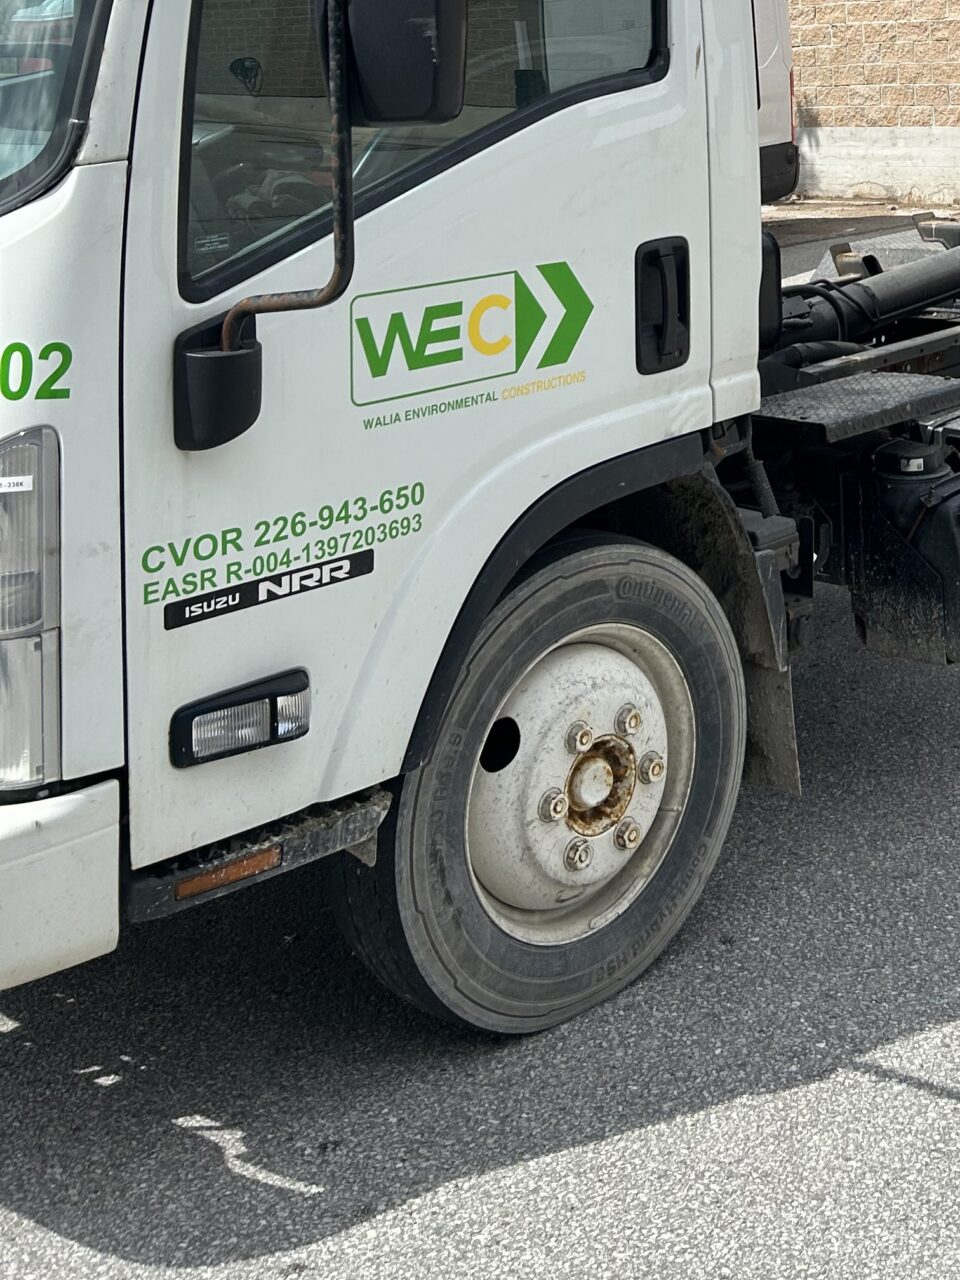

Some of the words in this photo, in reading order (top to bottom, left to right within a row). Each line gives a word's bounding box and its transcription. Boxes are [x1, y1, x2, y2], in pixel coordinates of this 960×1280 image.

[0, 341, 73, 401] 02
[355, 293, 513, 379] WEC
[363, 412, 402, 431] WALIA
[404, 391, 498, 422] ENVIRONMENTAL
[501, 370, 587, 401] CONSTRUCTIONS
[141, 527, 244, 574] CVOR
[253, 481, 425, 548] 226-943-650
[143, 567, 217, 605] EASR
[226, 513, 423, 584] R-004-1397203693
[184, 592, 240, 619] ISUZU
[258, 559, 351, 602] NRR
